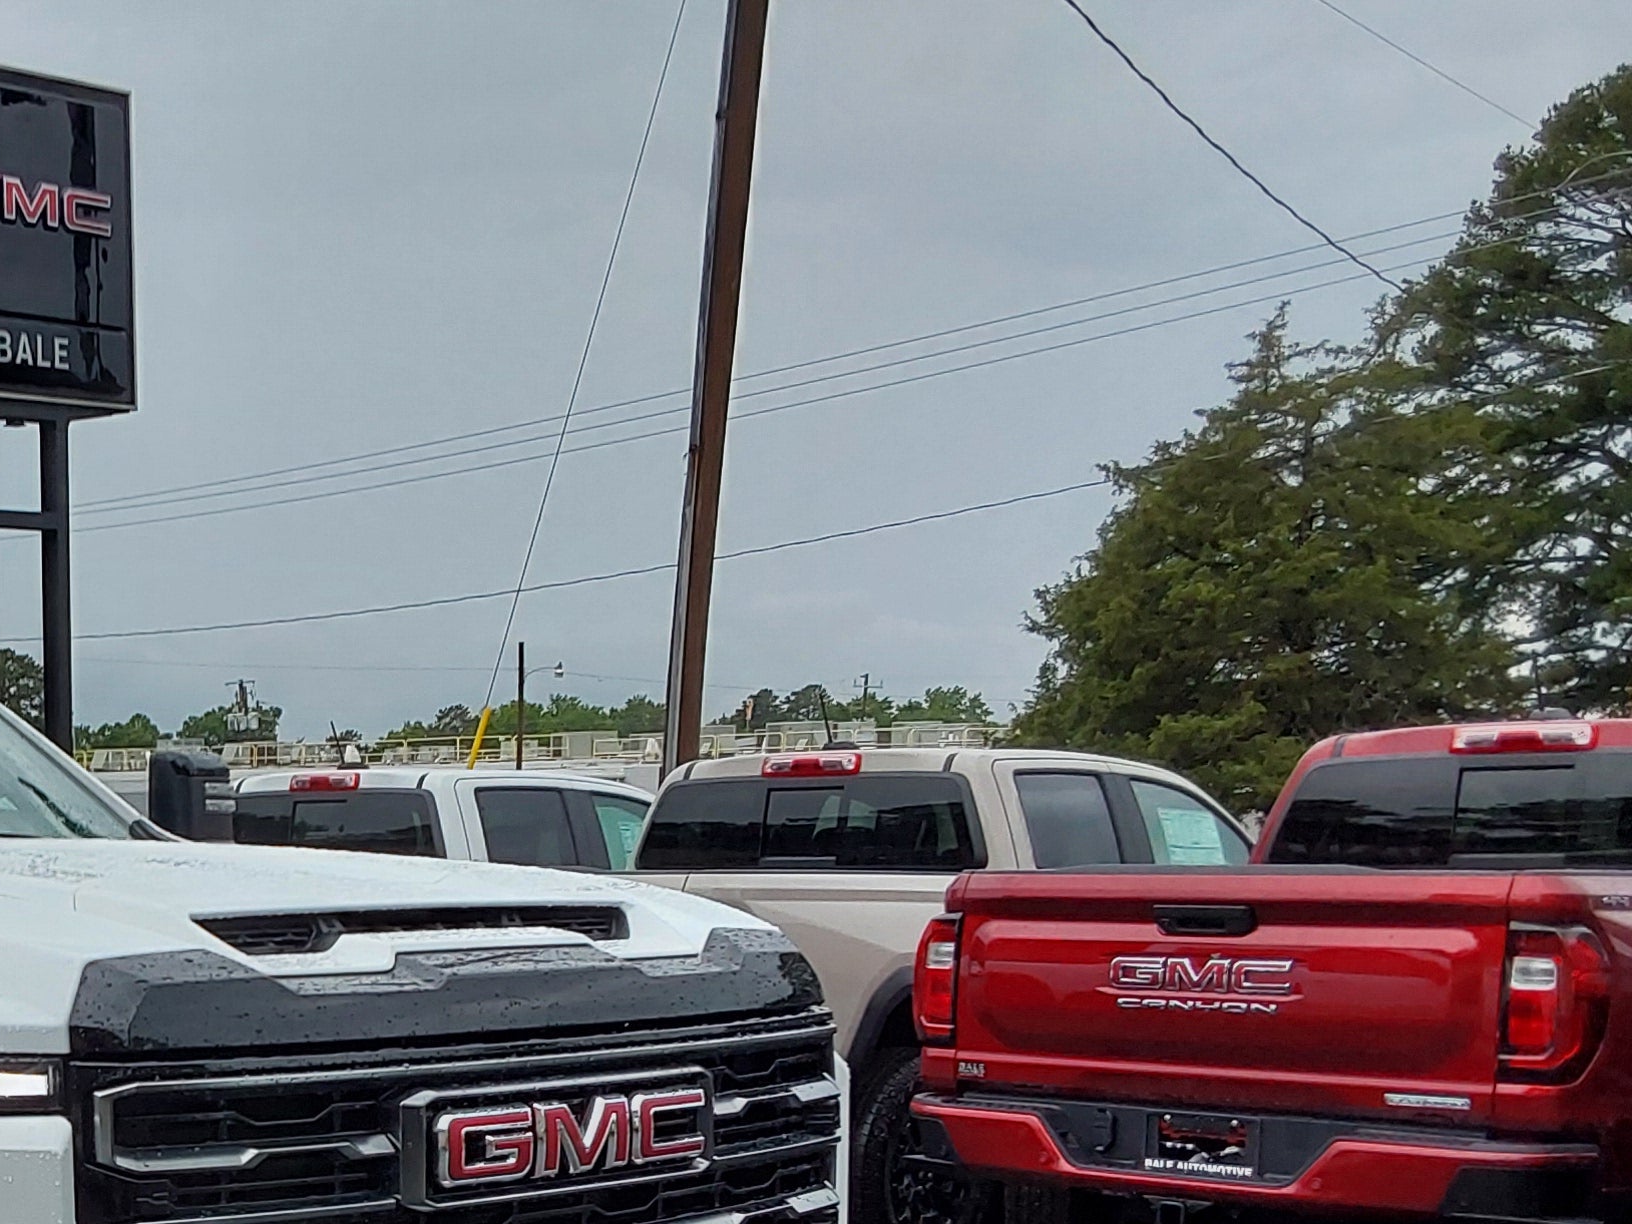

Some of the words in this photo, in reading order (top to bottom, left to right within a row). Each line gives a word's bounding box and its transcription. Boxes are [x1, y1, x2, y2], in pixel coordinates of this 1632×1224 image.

[1109, 956, 1293, 995] GMC
[1116, 997, 1278, 1015] CANYON
[433, 1089, 705, 1184] GMC
